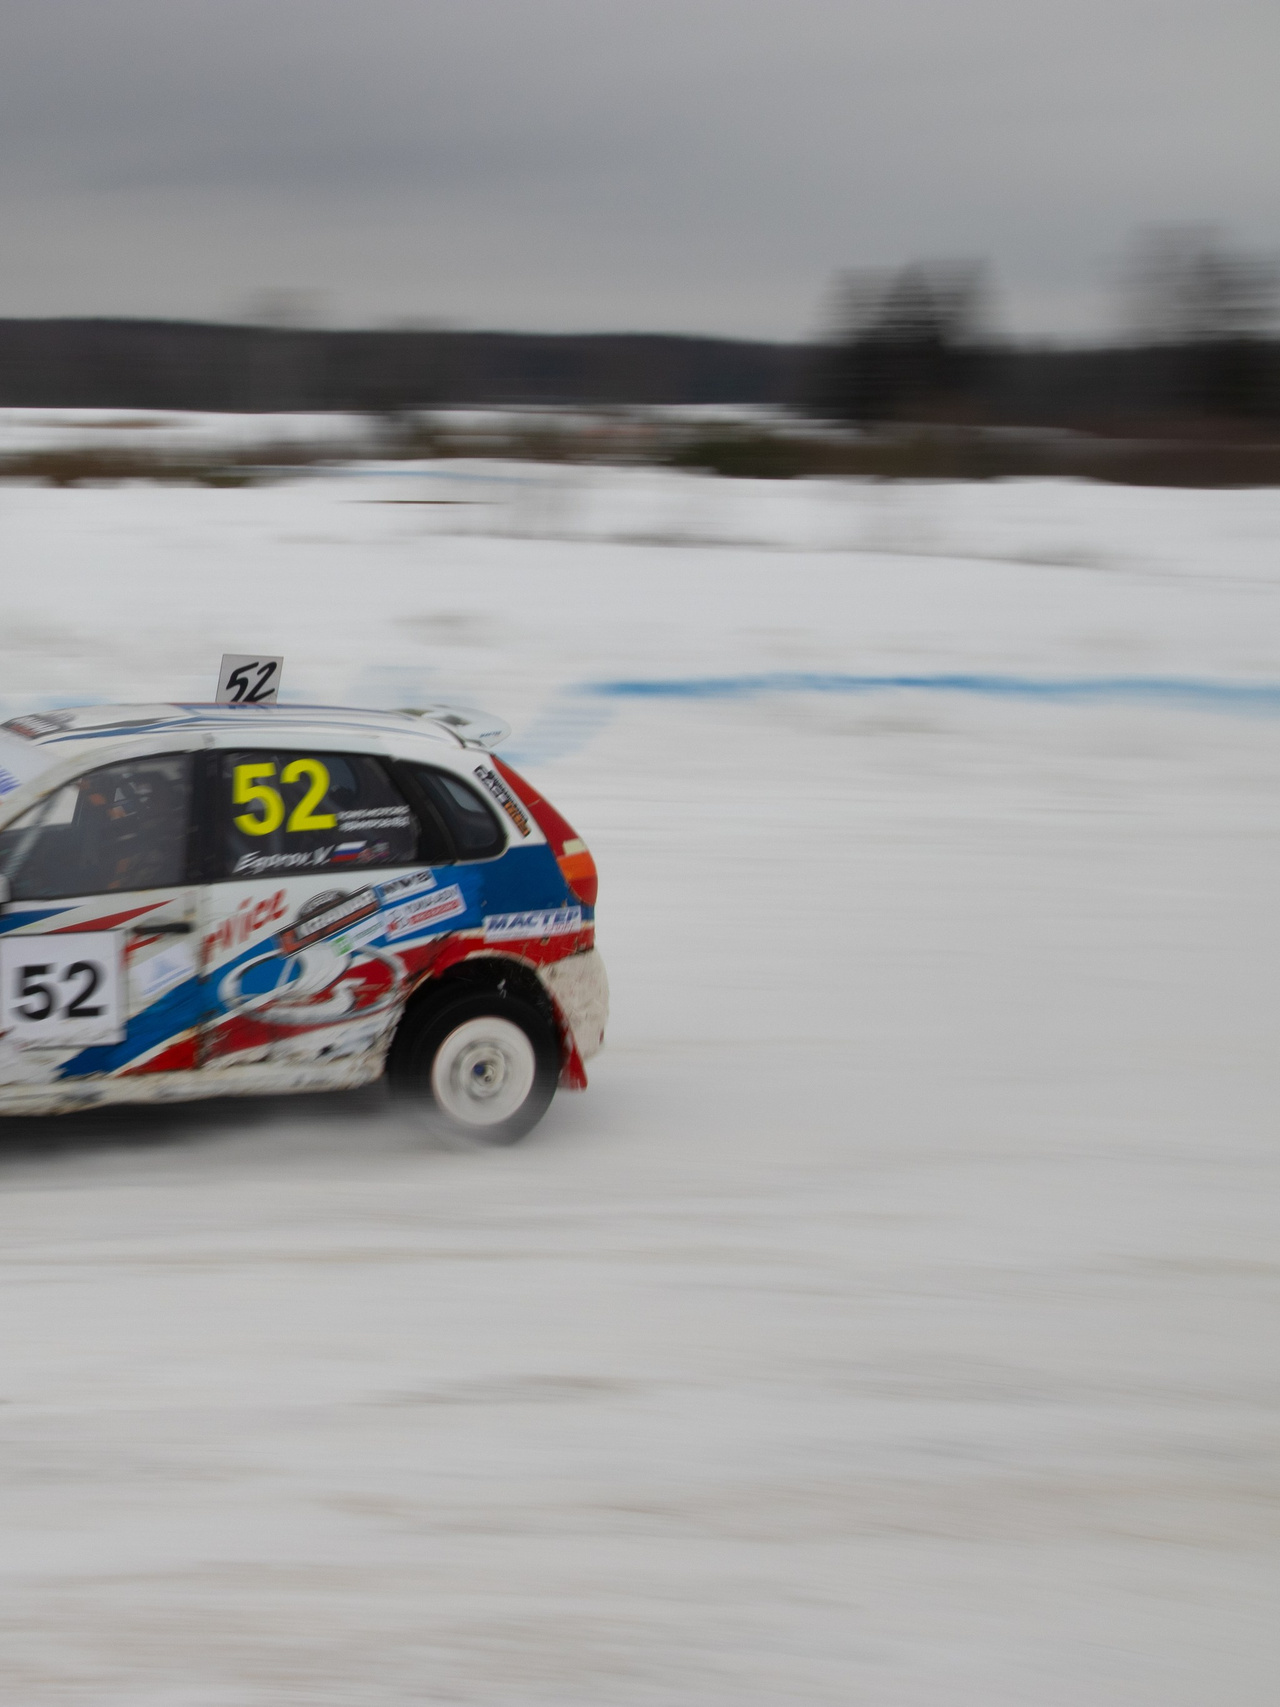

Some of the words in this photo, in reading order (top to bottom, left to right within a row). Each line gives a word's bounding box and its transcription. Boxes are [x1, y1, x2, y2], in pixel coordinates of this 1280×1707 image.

[225, 661, 277, 703] 52
[232, 758, 338, 836] 52
[14, 961, 109, 1020] 52
